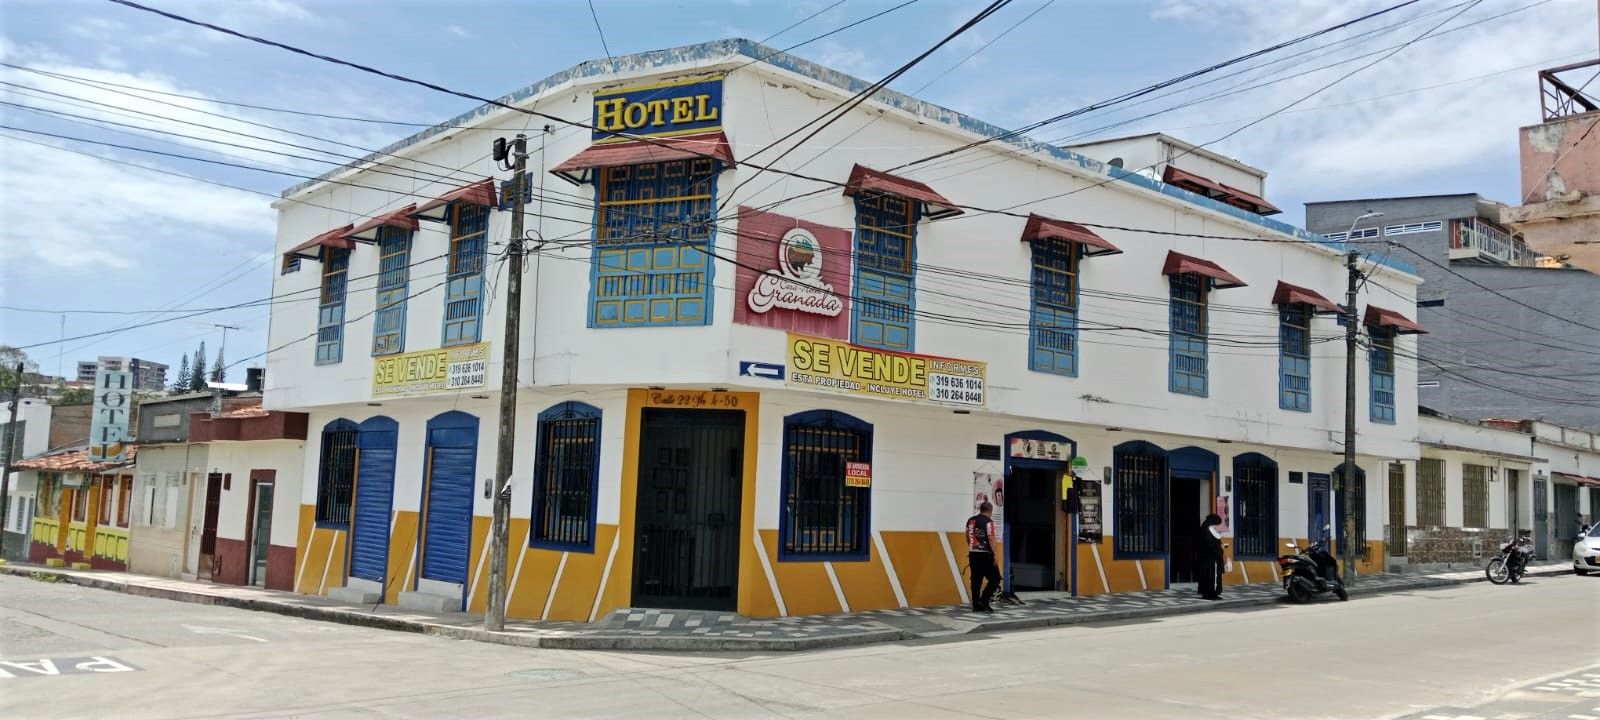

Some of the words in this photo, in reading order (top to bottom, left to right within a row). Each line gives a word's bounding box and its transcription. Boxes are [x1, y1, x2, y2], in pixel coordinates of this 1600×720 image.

[594, 95, 718, 132] HOTEL
[753, 274, 840, 311] Granada
[376, 359, 395, 384] SE
[398, 352, 447, 382] VENDE
[794, 340, 830, 373] SE
[837, 346, 925, 386] VENDE
[792, 372, 814, 384] ESTA
[815, 375, 860, 390] PROPIEDAD
[867, 384, 901, 395] INCLUYE
[902, 388, 926, 399] HOTEL
[936, 375, 949, 387] 319
[950, 377, 964, 388] 636
[965, 378, 982, 390] 1014
[936, 387, 949, 399] 310
[950, 389, 964, 400] 264
[965, 390, 982, 403] 8448
[100, 373, 127, 460] HOTEL
[0, 656, 135, 678] PA
